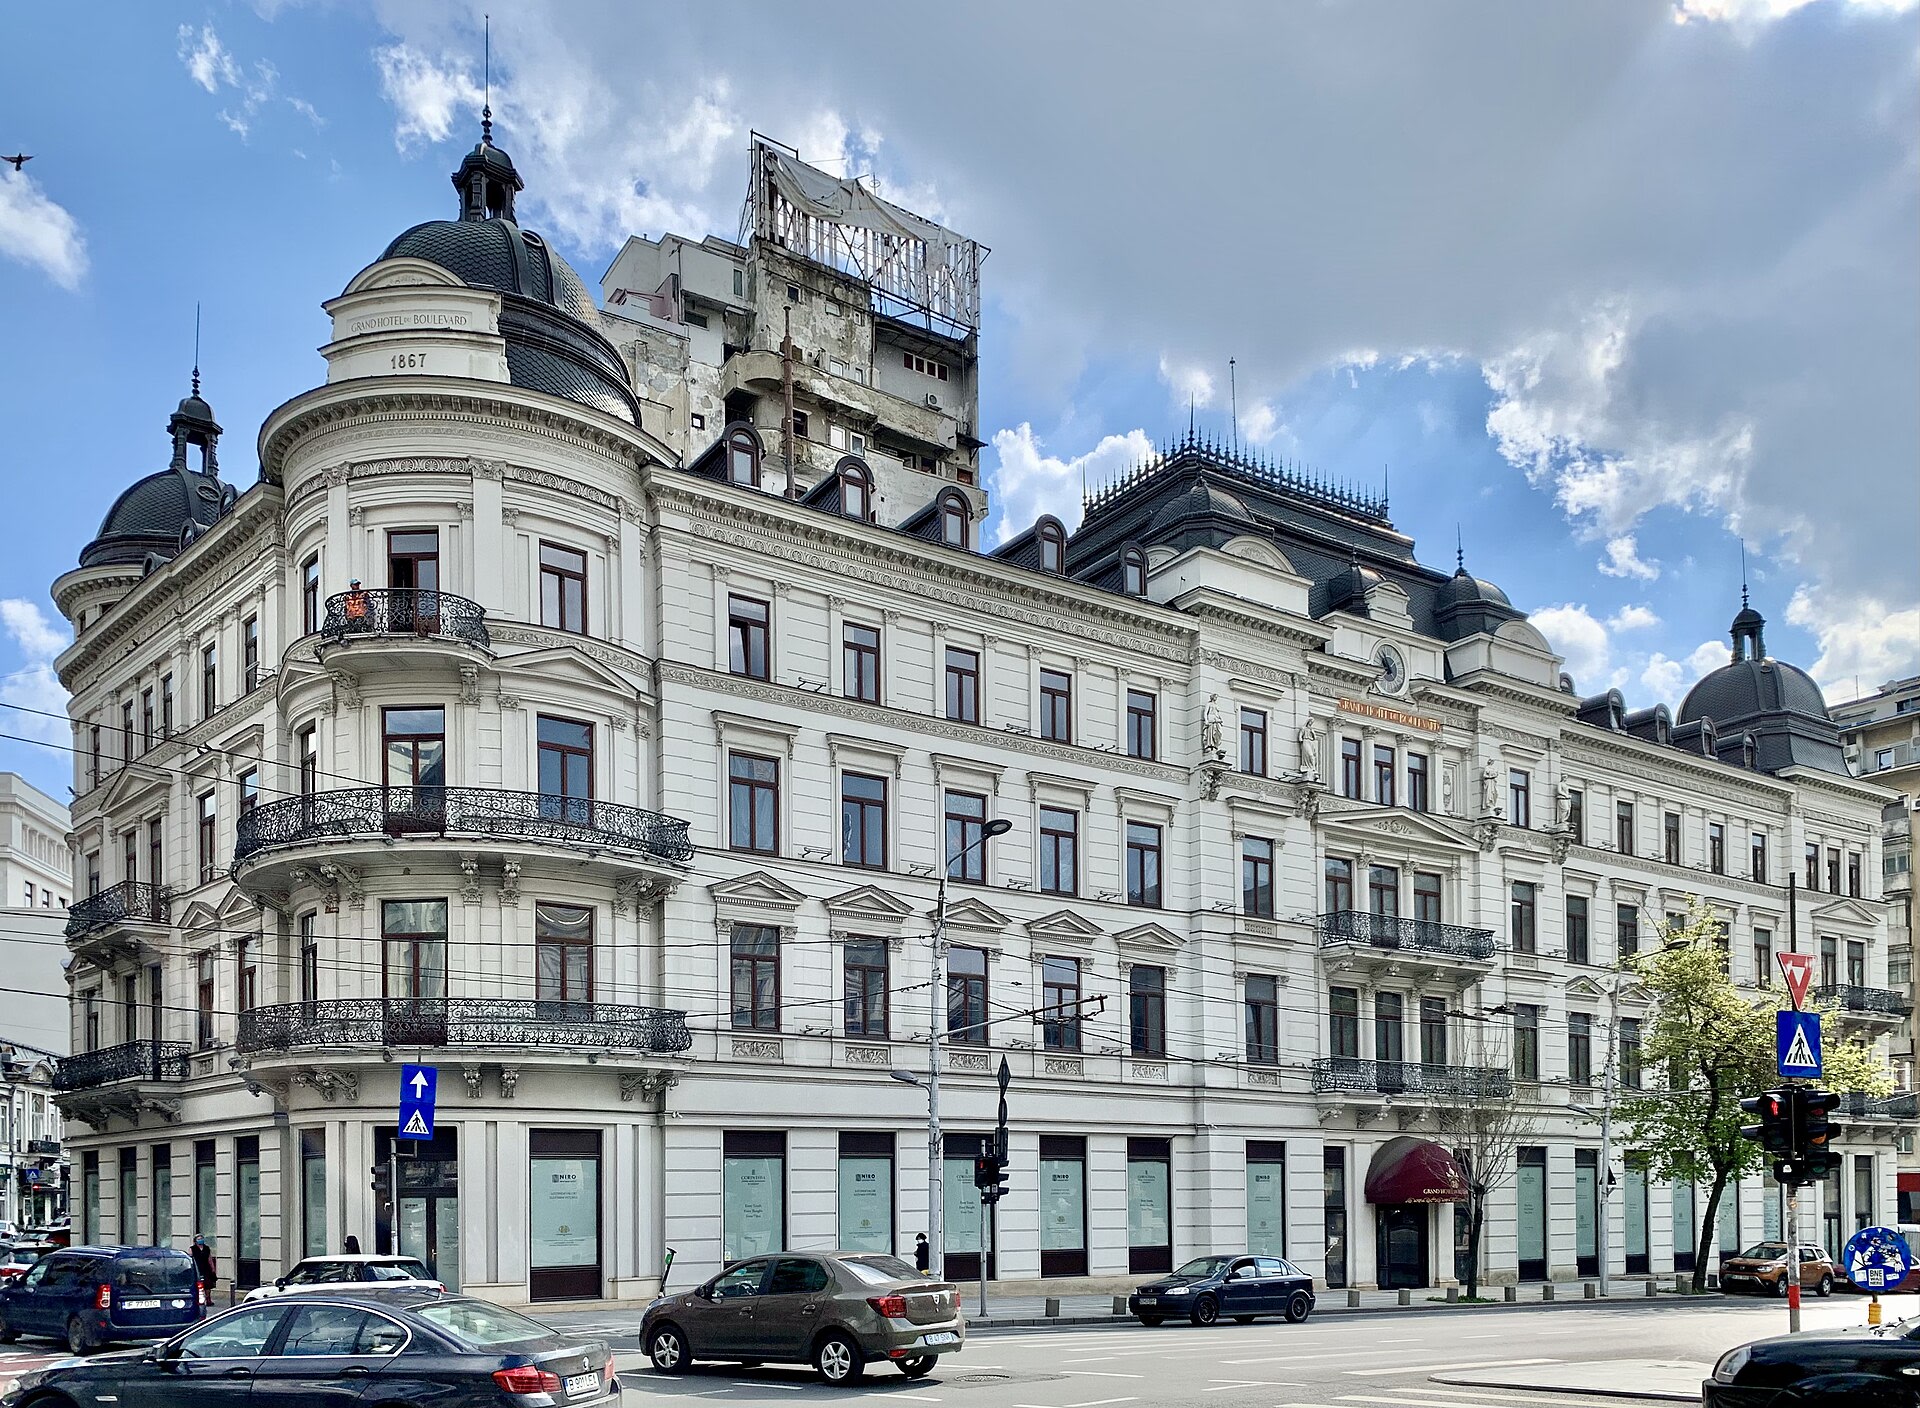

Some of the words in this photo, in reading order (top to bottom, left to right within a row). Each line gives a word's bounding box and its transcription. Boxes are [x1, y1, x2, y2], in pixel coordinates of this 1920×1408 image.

[351, 319, 377, 333] GRAND
[377, 316, 404, 327] HOTEL
[413, 314, 467, 325] BOULEVARD
[391, 353, 427, 369] 1867
[568, 1379, 574, 1390] B
